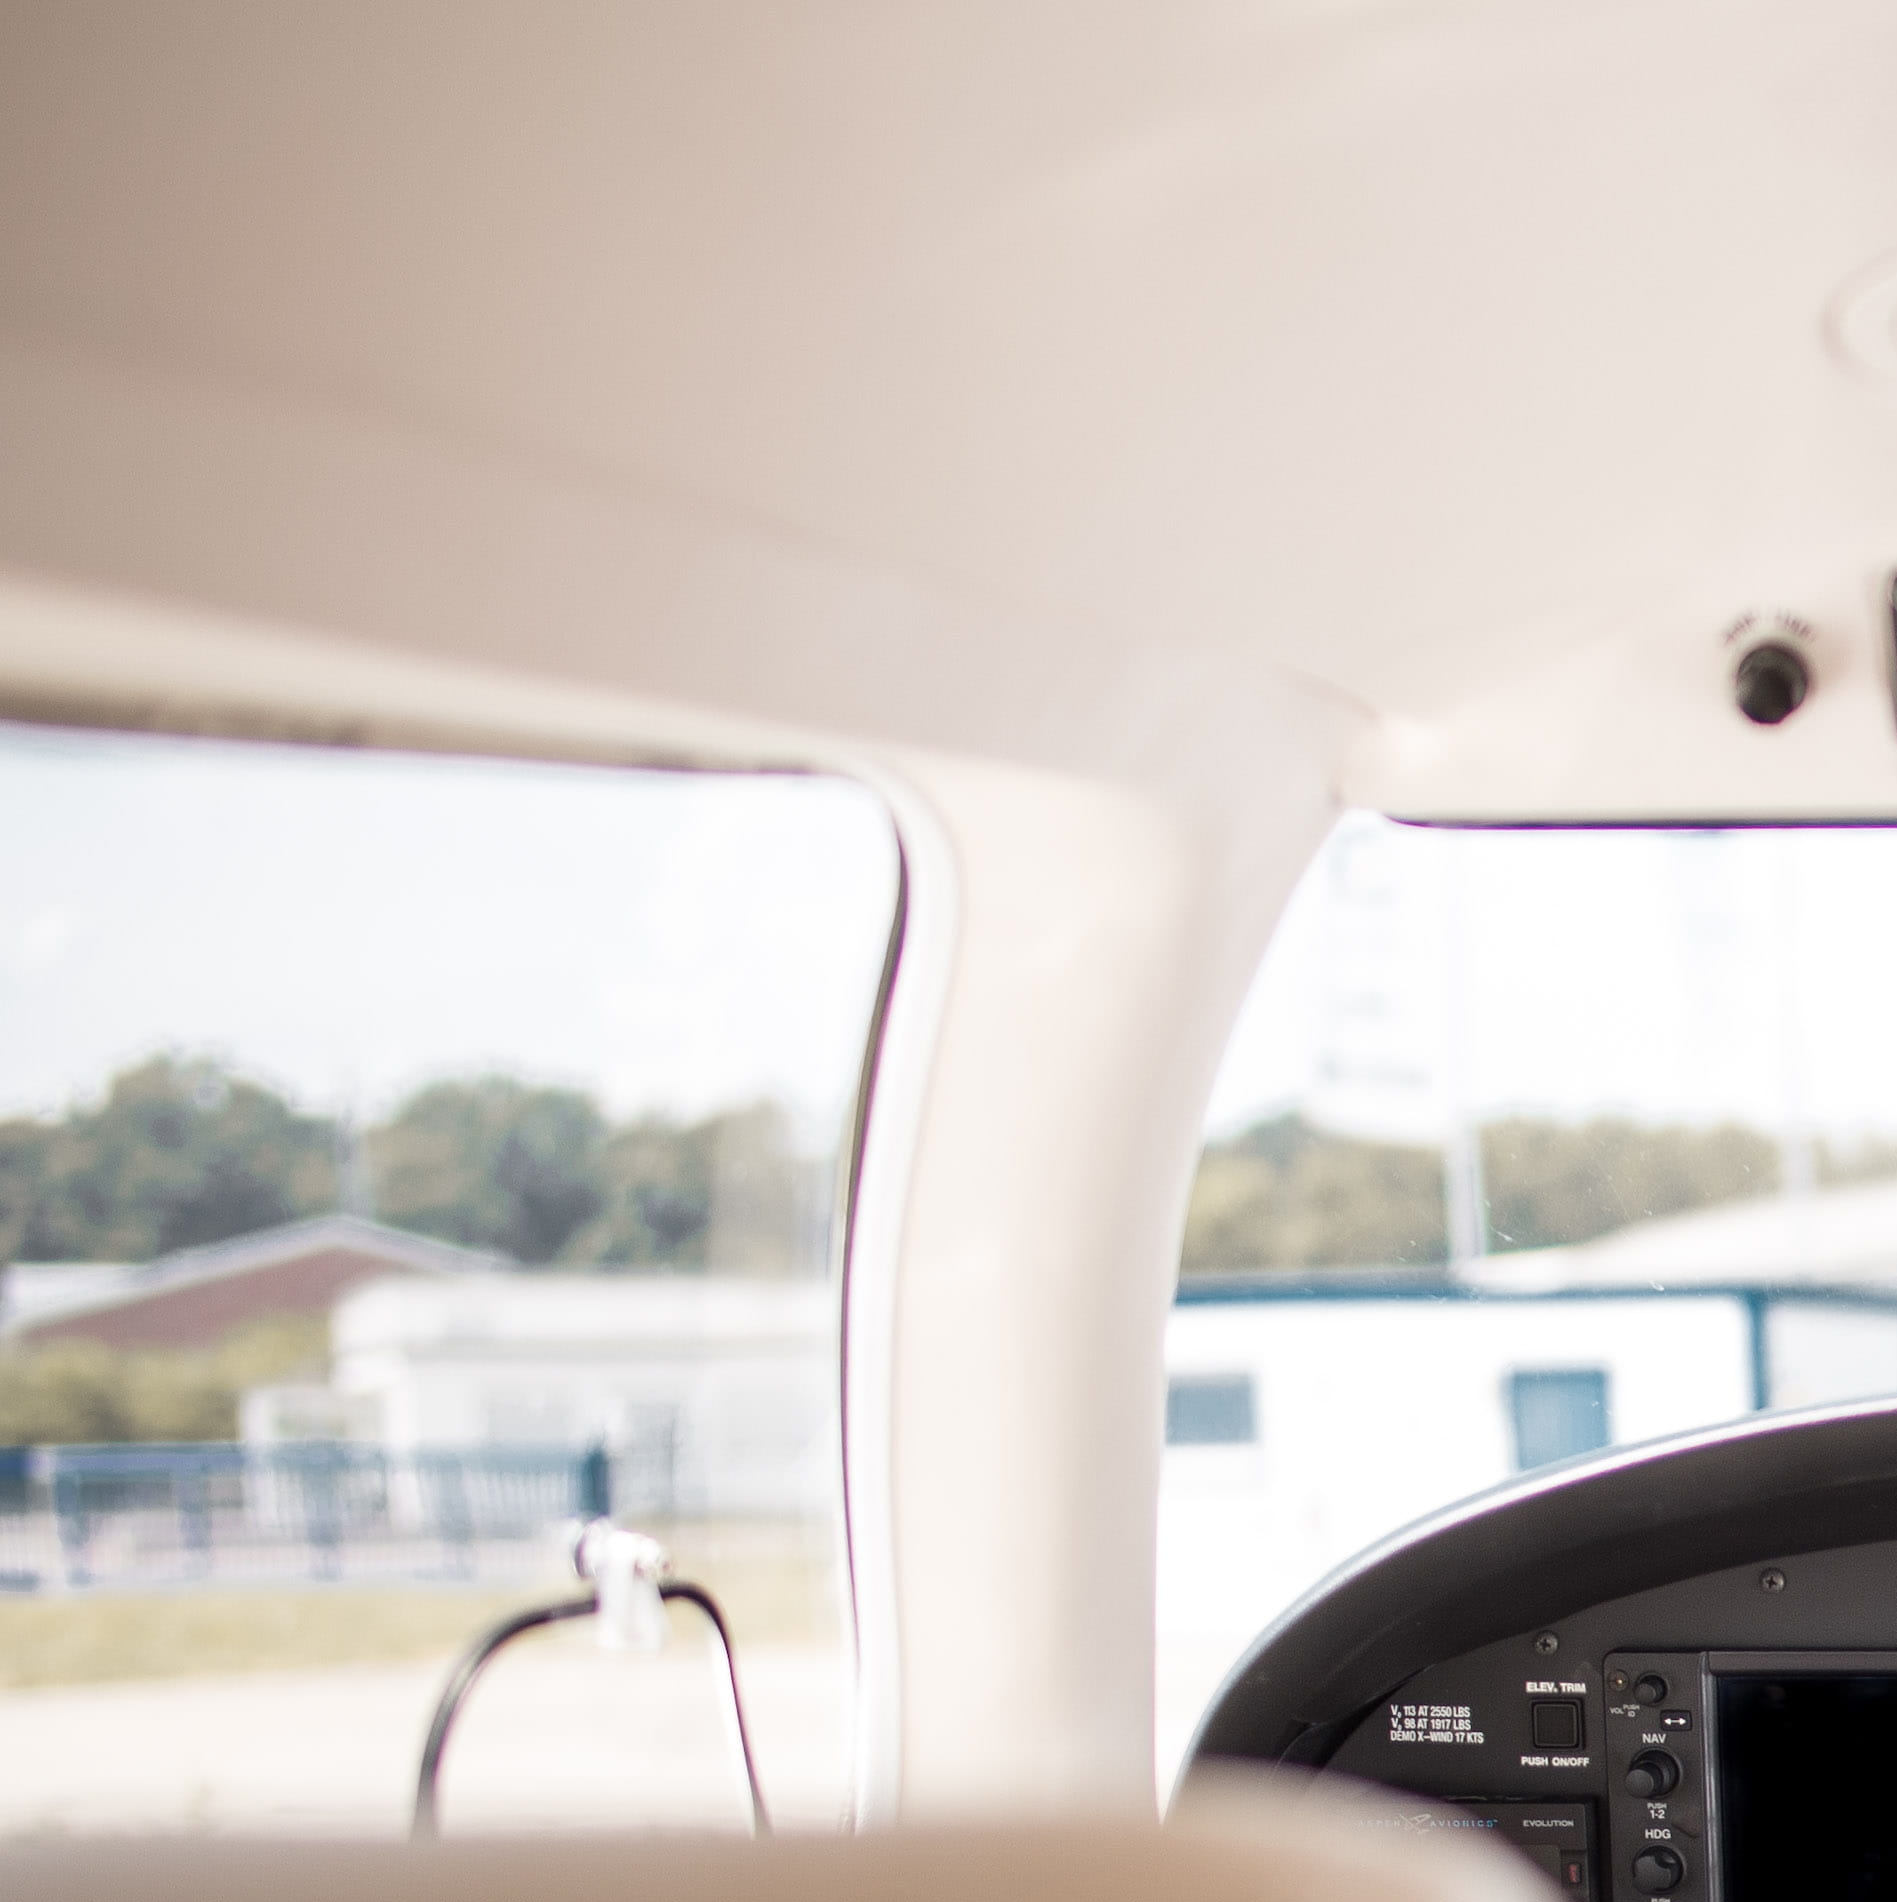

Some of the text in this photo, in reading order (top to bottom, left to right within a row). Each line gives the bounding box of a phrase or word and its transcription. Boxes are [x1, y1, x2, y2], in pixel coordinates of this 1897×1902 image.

[1525, 1682, 1587, 1694] ELEV. TRIM
[1404, 1705, 1471, 1718] 113 AT 2550 LBS
[1417, 1719, 1428, 1729] AT
[1431, 1719, 1451, 1730] 1917
[1453, 1719, 1472, 1731] LBS
[1390, 1730, 1416, 1742] DEMO
[1455, 1732, 1464, 1743] 17
[1467, 1732, 1484, 1744] KTS
[1642, 1733, 1666, 1744] NAV
[1521, 1756, 1590, 1768] PUSH ON/OFF
[1650, 1809, 1665, 1820] 1-2
[1523, 1820, 1574, 1828] EVOLUTION
[1644, 1828, 1671, 1840] HDG
